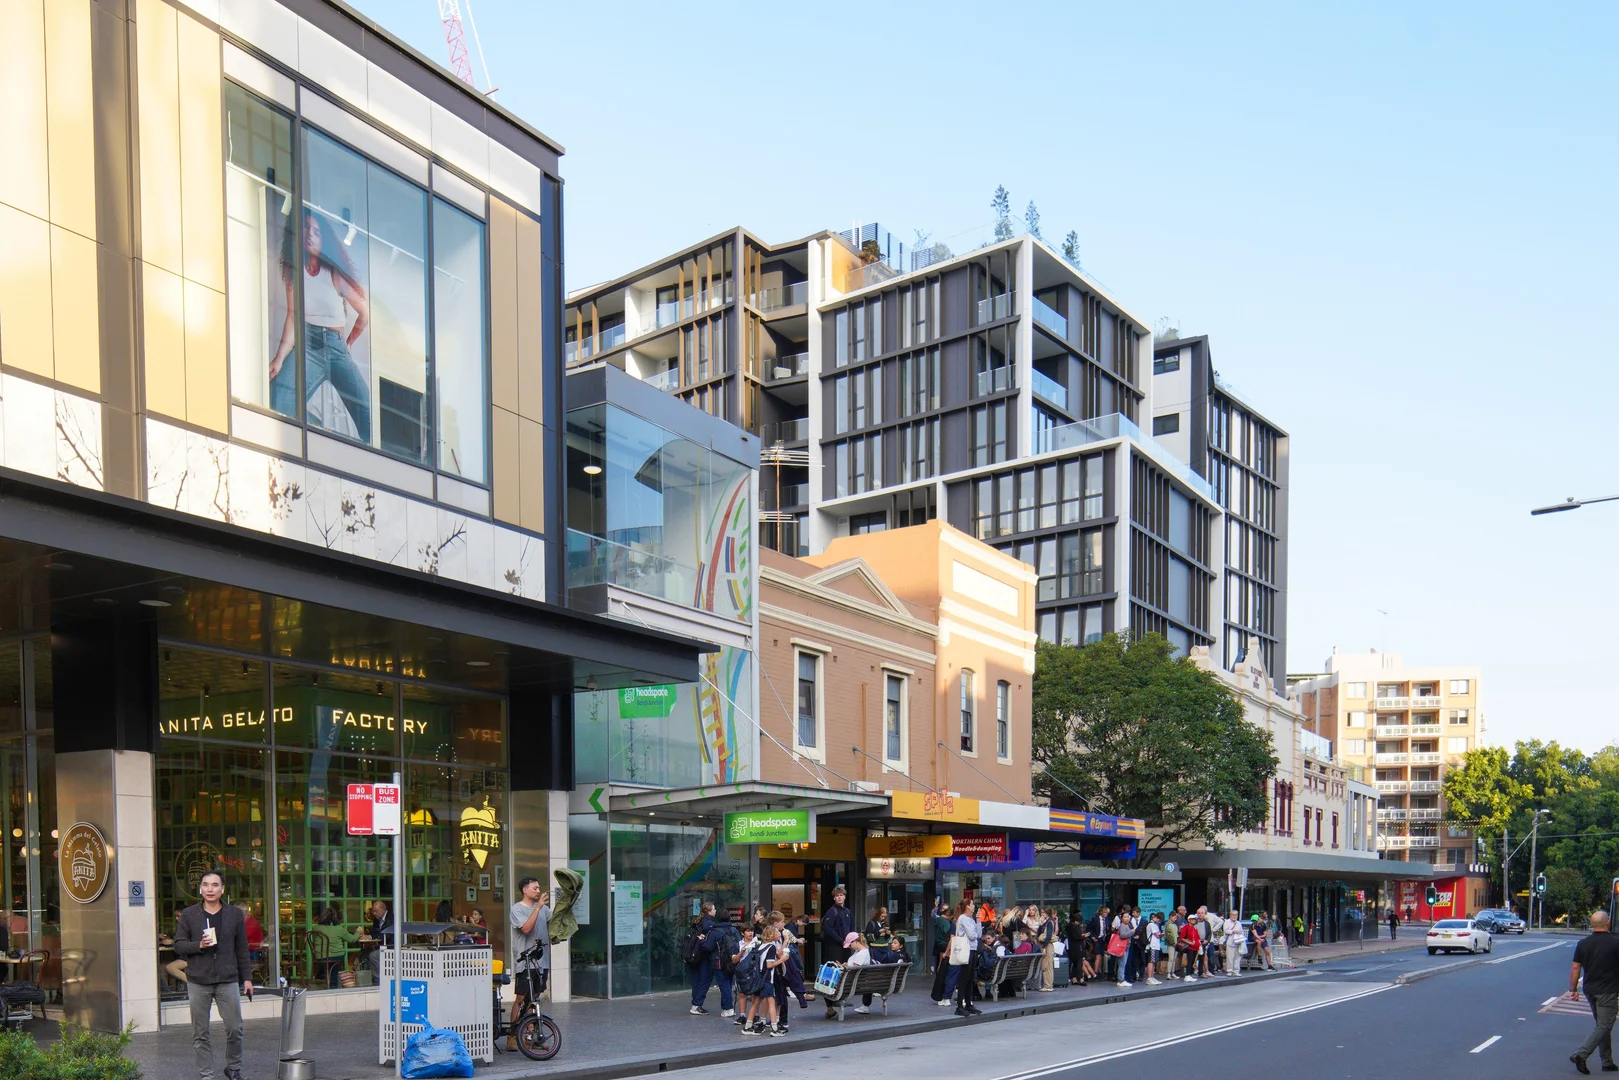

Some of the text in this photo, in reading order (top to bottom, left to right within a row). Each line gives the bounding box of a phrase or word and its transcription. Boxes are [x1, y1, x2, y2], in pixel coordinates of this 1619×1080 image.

[636, 687, 668, 698] headspace
[332, 709, 427, 735] FACTORY
[749, 817, 797, 829] headspace
[67, 832, 83, 849] Mamma
[91, 837, 102, 858] Gelato
[460, 830, 499, 848] ANITA
[74, 865, 95, 878] ANITA
